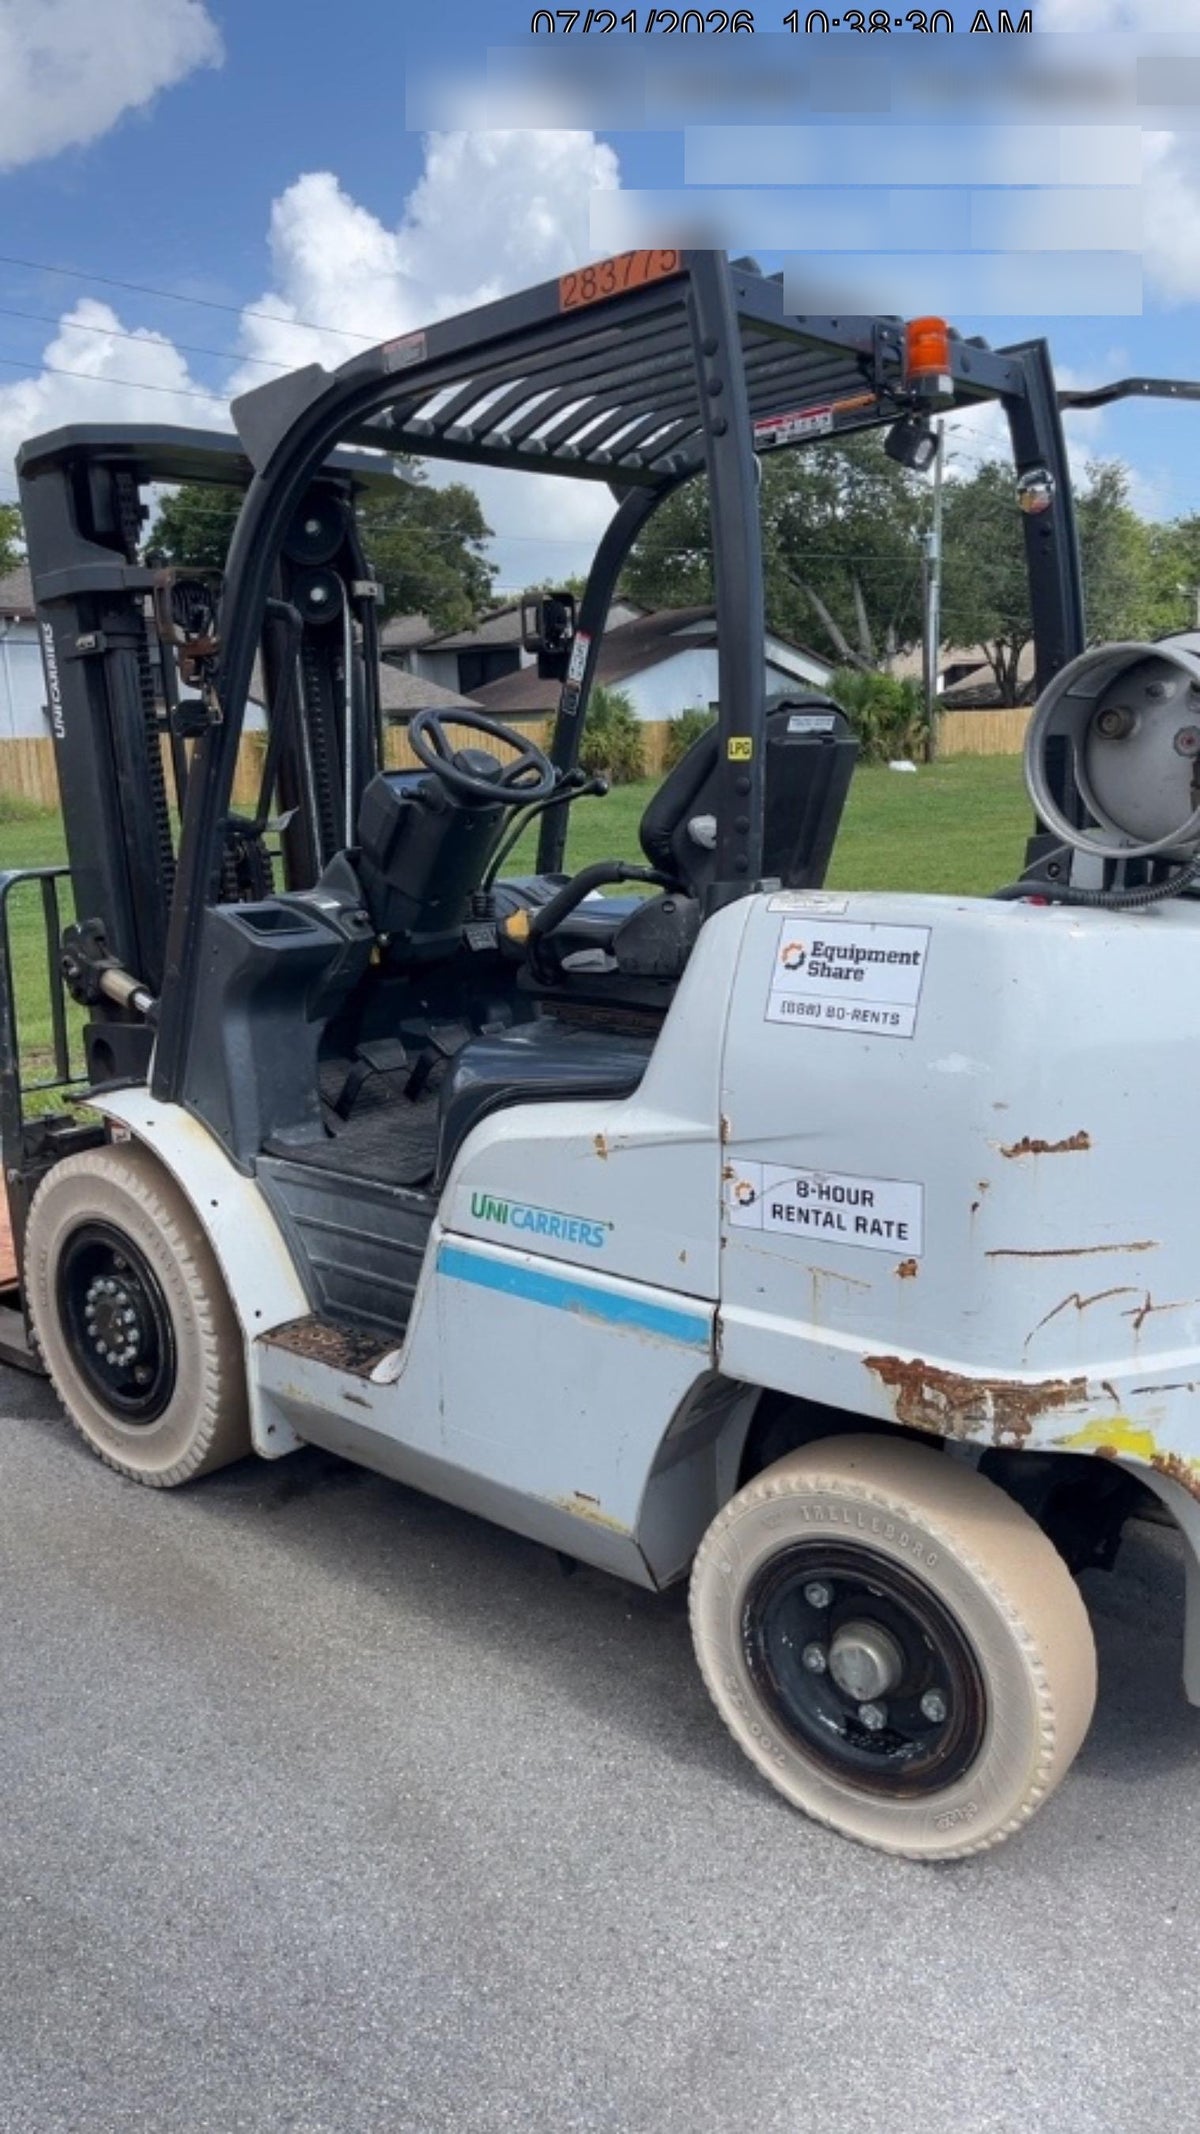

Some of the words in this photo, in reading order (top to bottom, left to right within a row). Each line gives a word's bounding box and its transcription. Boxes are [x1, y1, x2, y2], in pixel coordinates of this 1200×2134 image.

[563, 250, 677, 307] 283775
[729, 741, 751, 756] LPG
[810, 940, 922, 966] Equipment
[807, 960, 865, 982] Share
[780, 1000, 822, 1018] (888)
[825, 1006, 901, 1025] 80-RENTS
[796, 1180, 875, 1208] 8-HOUR
[771, 1203, 848, 1231] RENTAL
[854, 1215, 909, 1241] RATE
